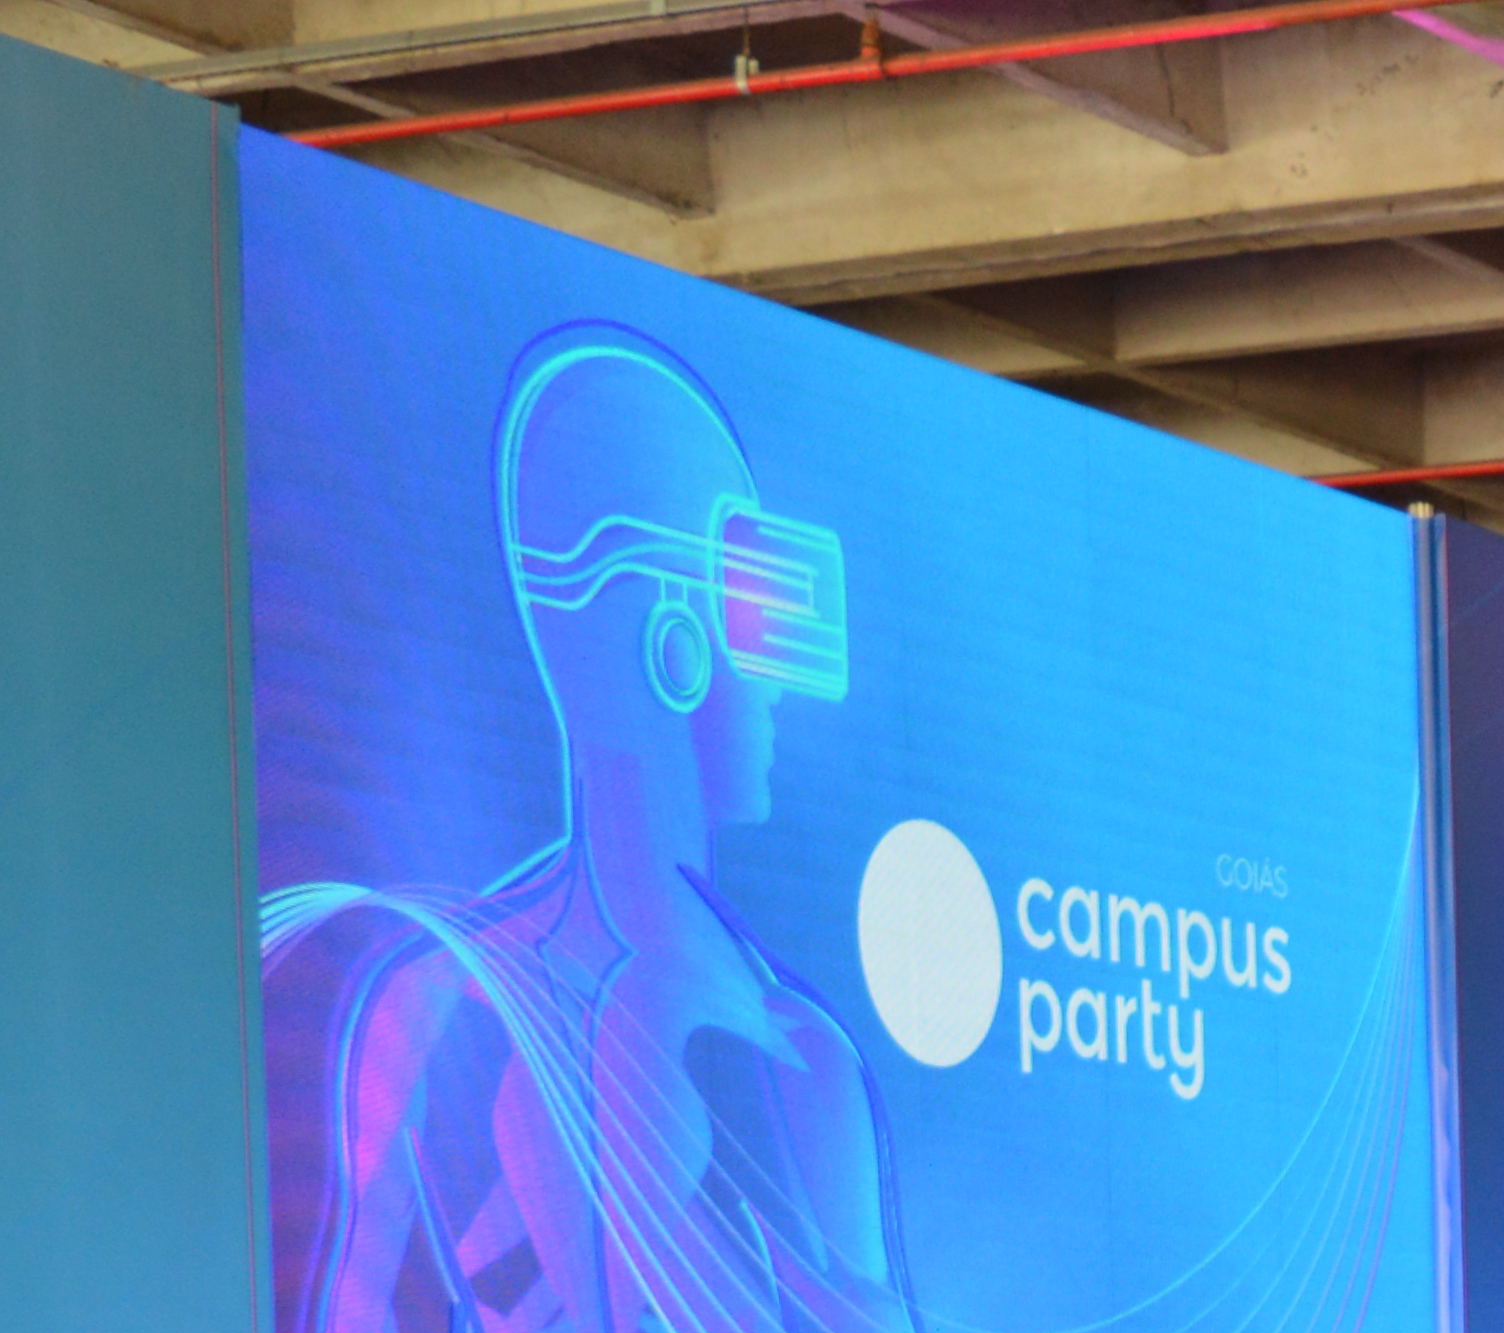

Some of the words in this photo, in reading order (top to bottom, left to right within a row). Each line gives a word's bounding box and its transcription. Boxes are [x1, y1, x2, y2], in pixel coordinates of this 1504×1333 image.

[1215, 853, 1289, 899] GOIÁS
[1016, 877, 1292, 999] campus
[1018, 976, 1206, 1100] party
